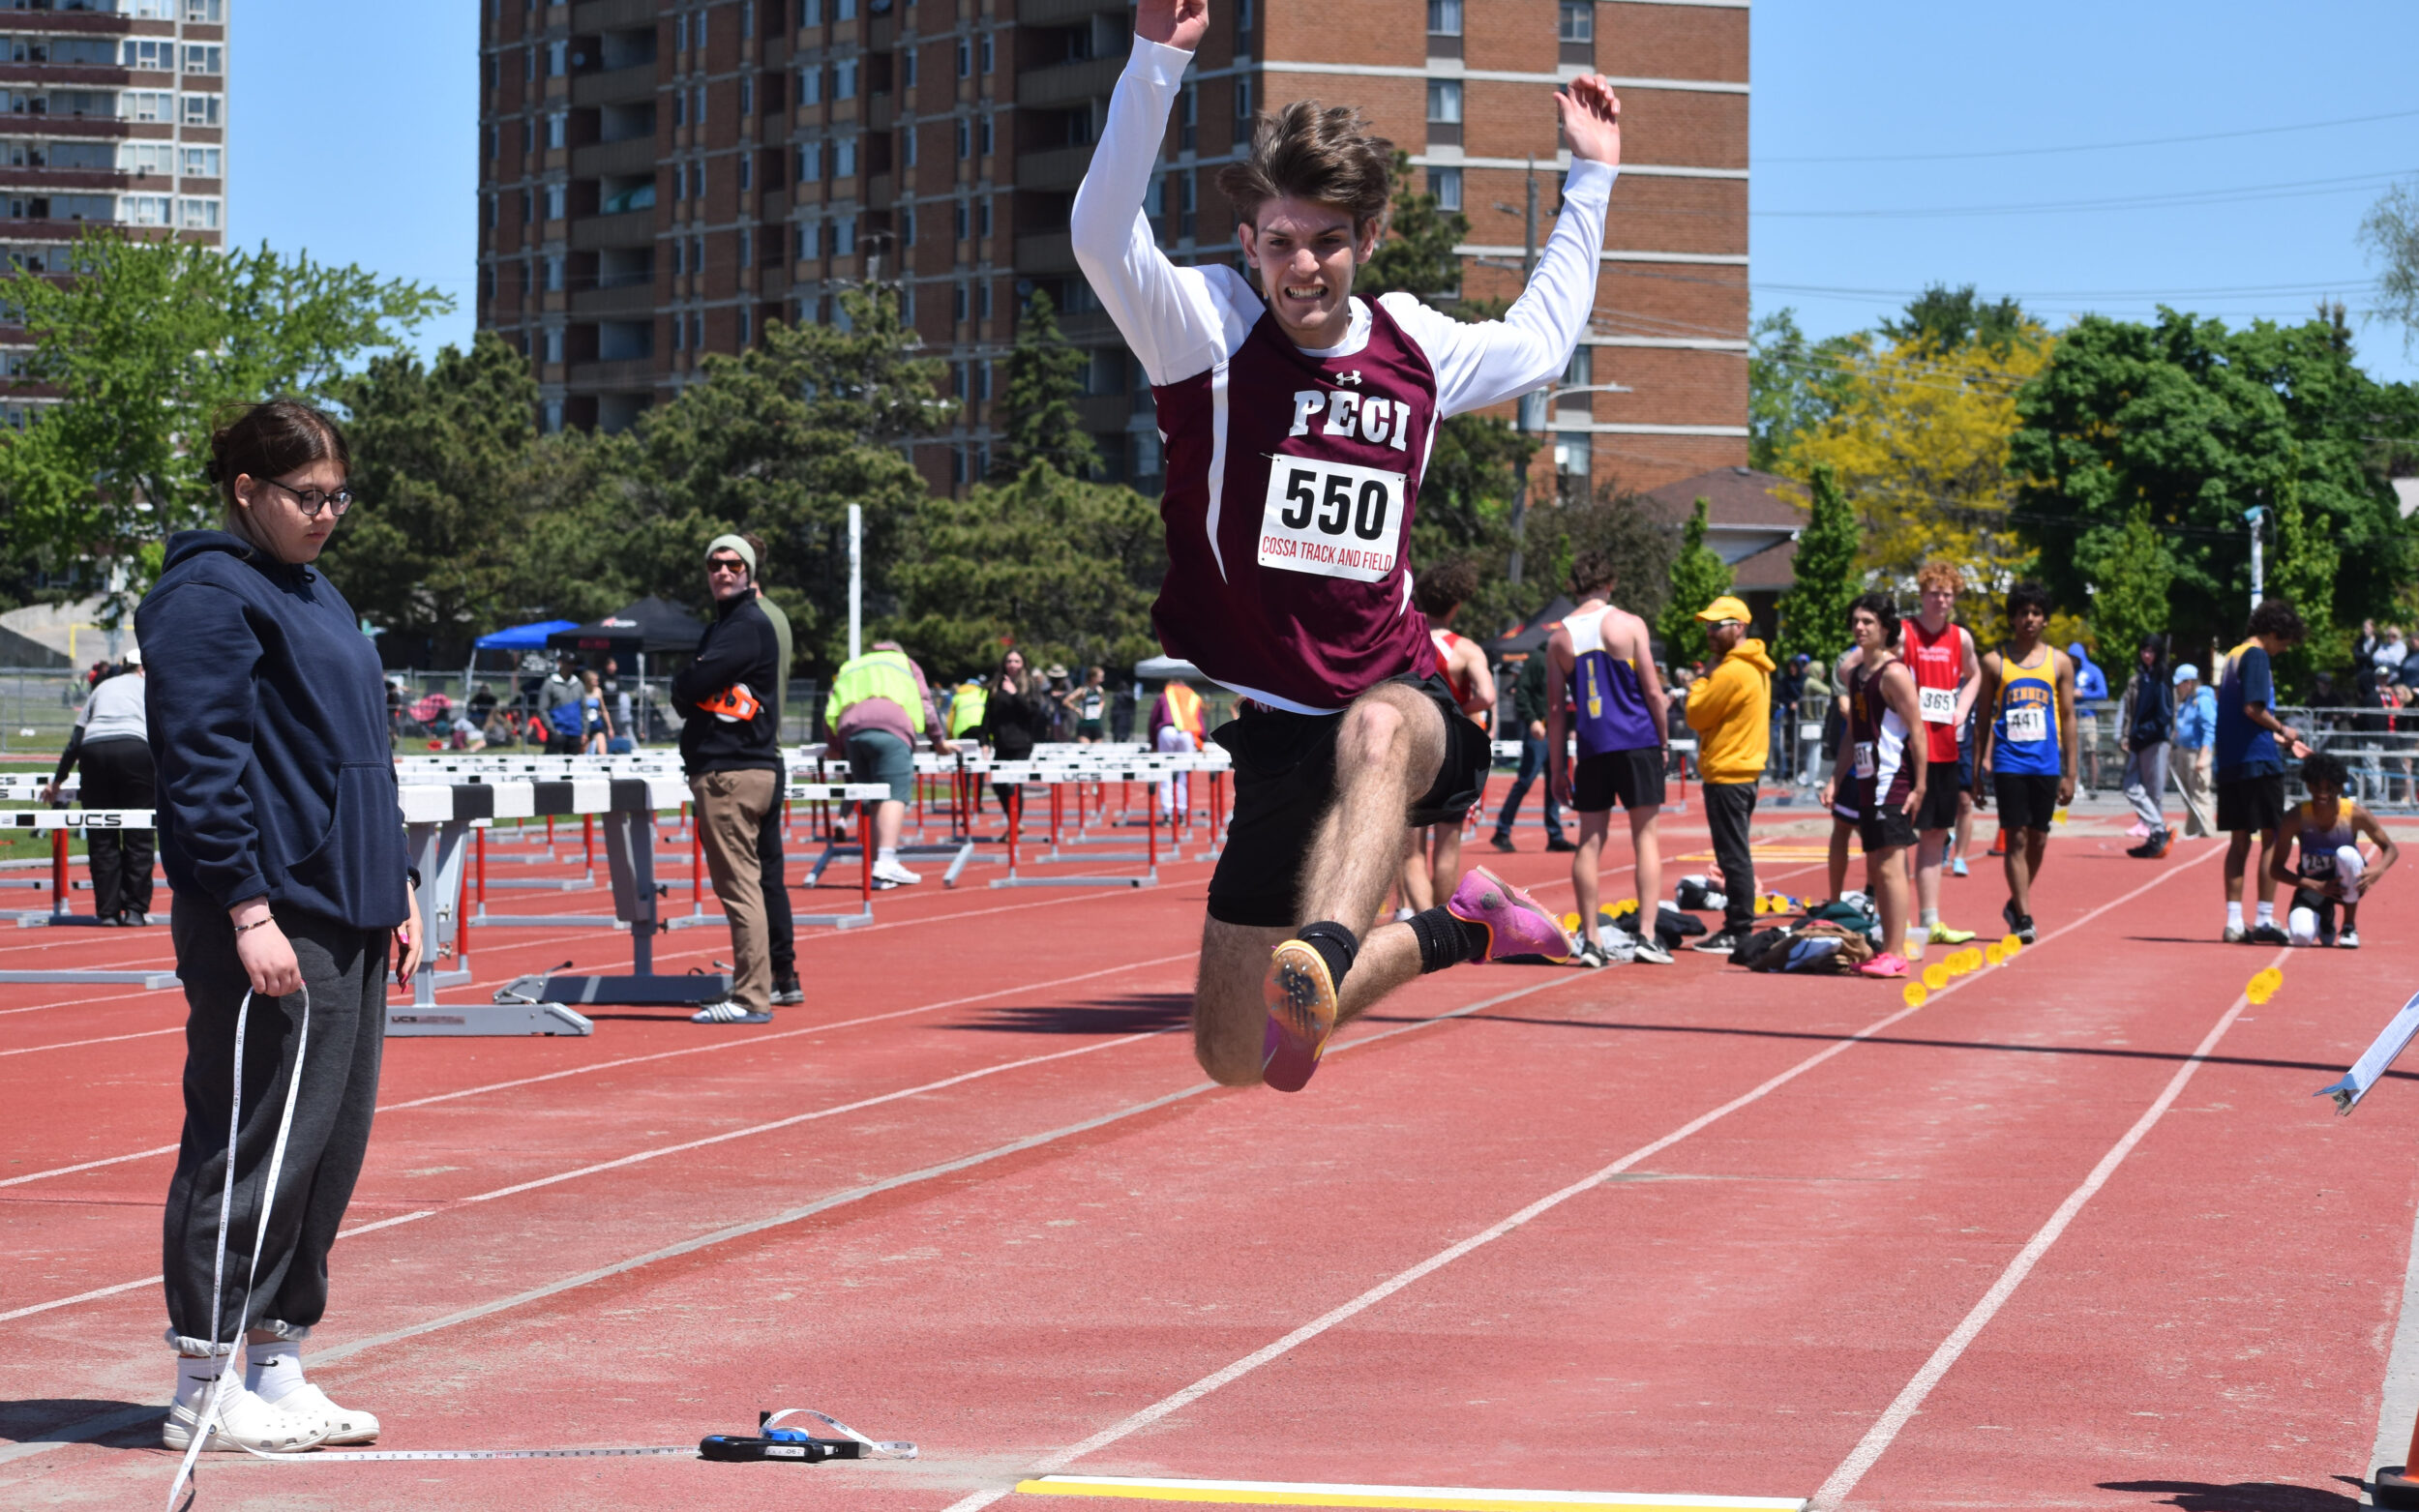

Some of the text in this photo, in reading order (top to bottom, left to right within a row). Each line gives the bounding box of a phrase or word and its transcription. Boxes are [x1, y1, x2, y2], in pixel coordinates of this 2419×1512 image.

[1289, 390, 1411, 452] PECI
[1281, 468, 1389, 541] 550
[1262, 536, 1392, 572] COSSA TRACK AND FIELD
[1924, 692, 1950, 711] 365
[2012, 713, 2038, 729] 441
[1062, 772, 1102, 782] UCS
[65, 814, 122, 826] UCS
